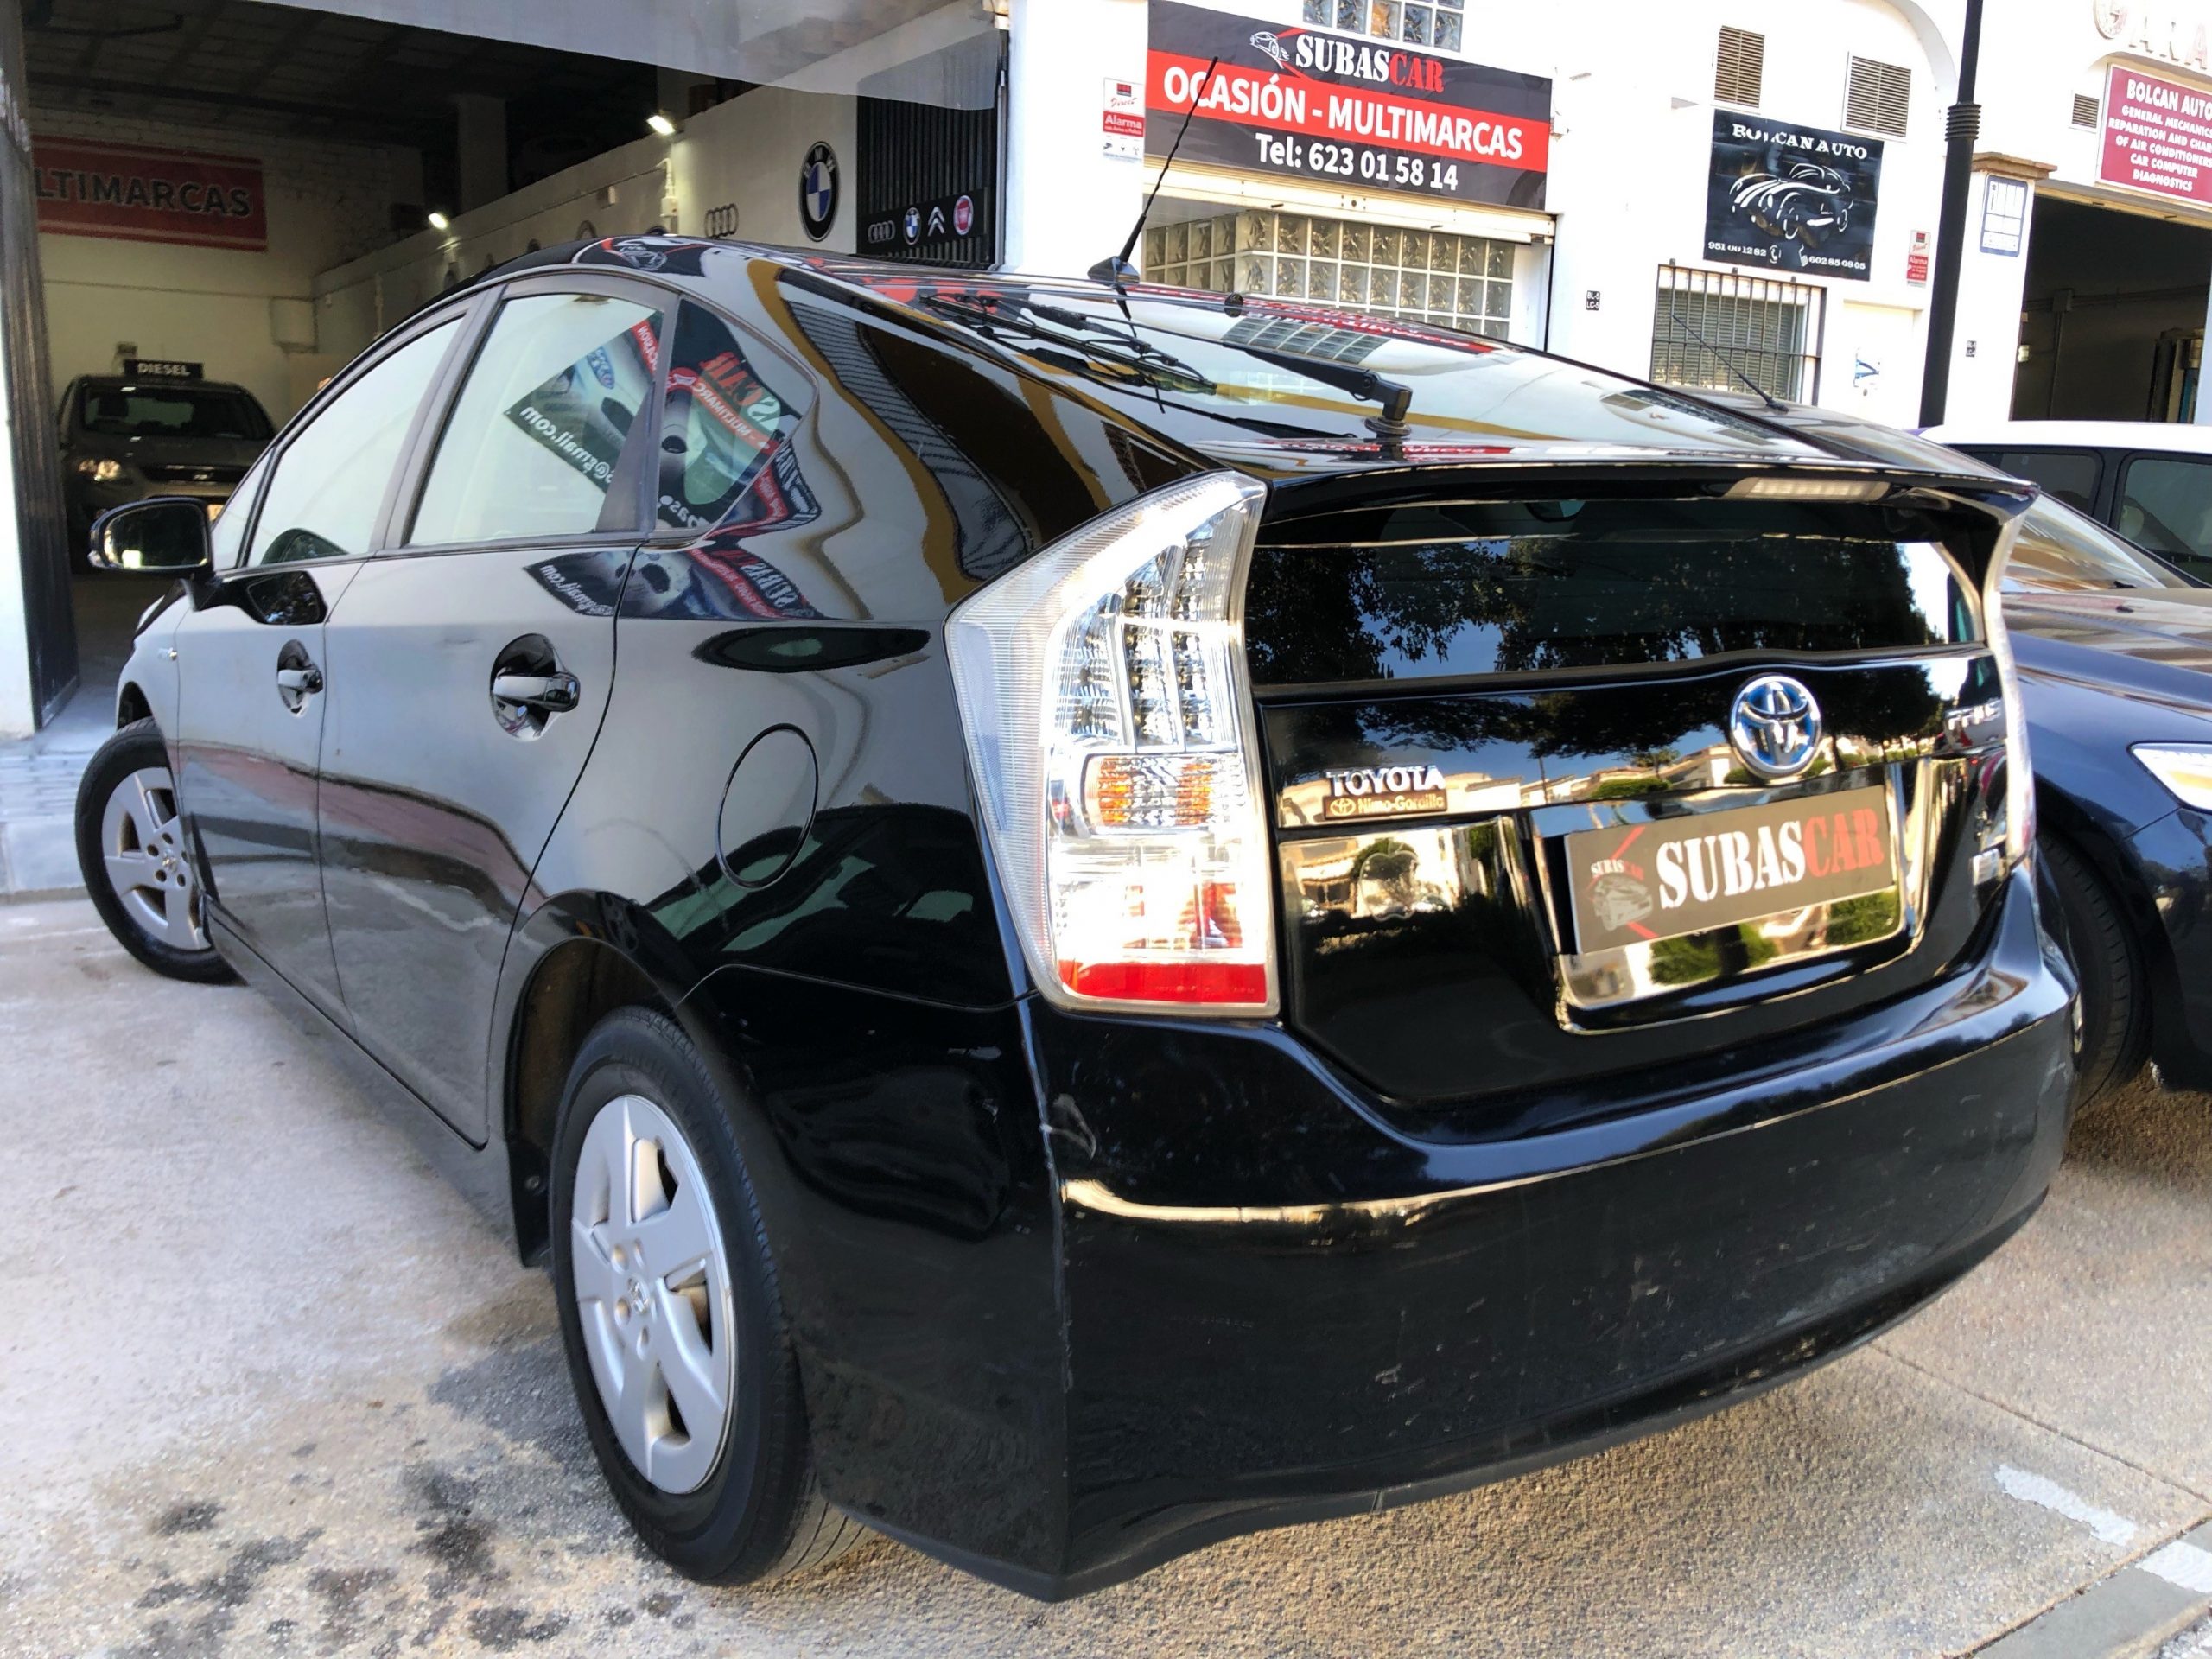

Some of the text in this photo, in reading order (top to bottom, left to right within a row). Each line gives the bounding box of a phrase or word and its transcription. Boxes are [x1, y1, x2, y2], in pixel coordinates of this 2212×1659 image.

[1295, 33, 1446, 93] SUBASCAR
[2126, 79, 2179, 111] BOLCAN
[1104, 113, 1143, 129] Alarma
[1163, 66, 1306, 124] OCASIÓN
[1327, 95, 1523, 161] MULTIMARCAS
[2121, 105, 2164, 126] GENERAL
[2108, 117, 2166, 141] REPARATION
[2167, 132, 2188, 147] AND
[2115, 135, 2129, 148] OF
[2130, 138, 2148, 152] AIR
[1255, 132, 1459, 191] Tel: 623 01 58 14
[1815, 139, 1868, 160] AUTO
[2130, 153, 2198, 179] CAR COMPUTER
[2132, 168, 2193, 192] DIAGNOSTICS
[33, 168, 251, 218] LTIMARCAS
[1707, 241, 1726, 251] 951
[137, 362, 191, 377] DIESEL
[1325, 764, 1447, 797] TOYOTA
[1655, 807, 1885, 911] SUBASCAR
